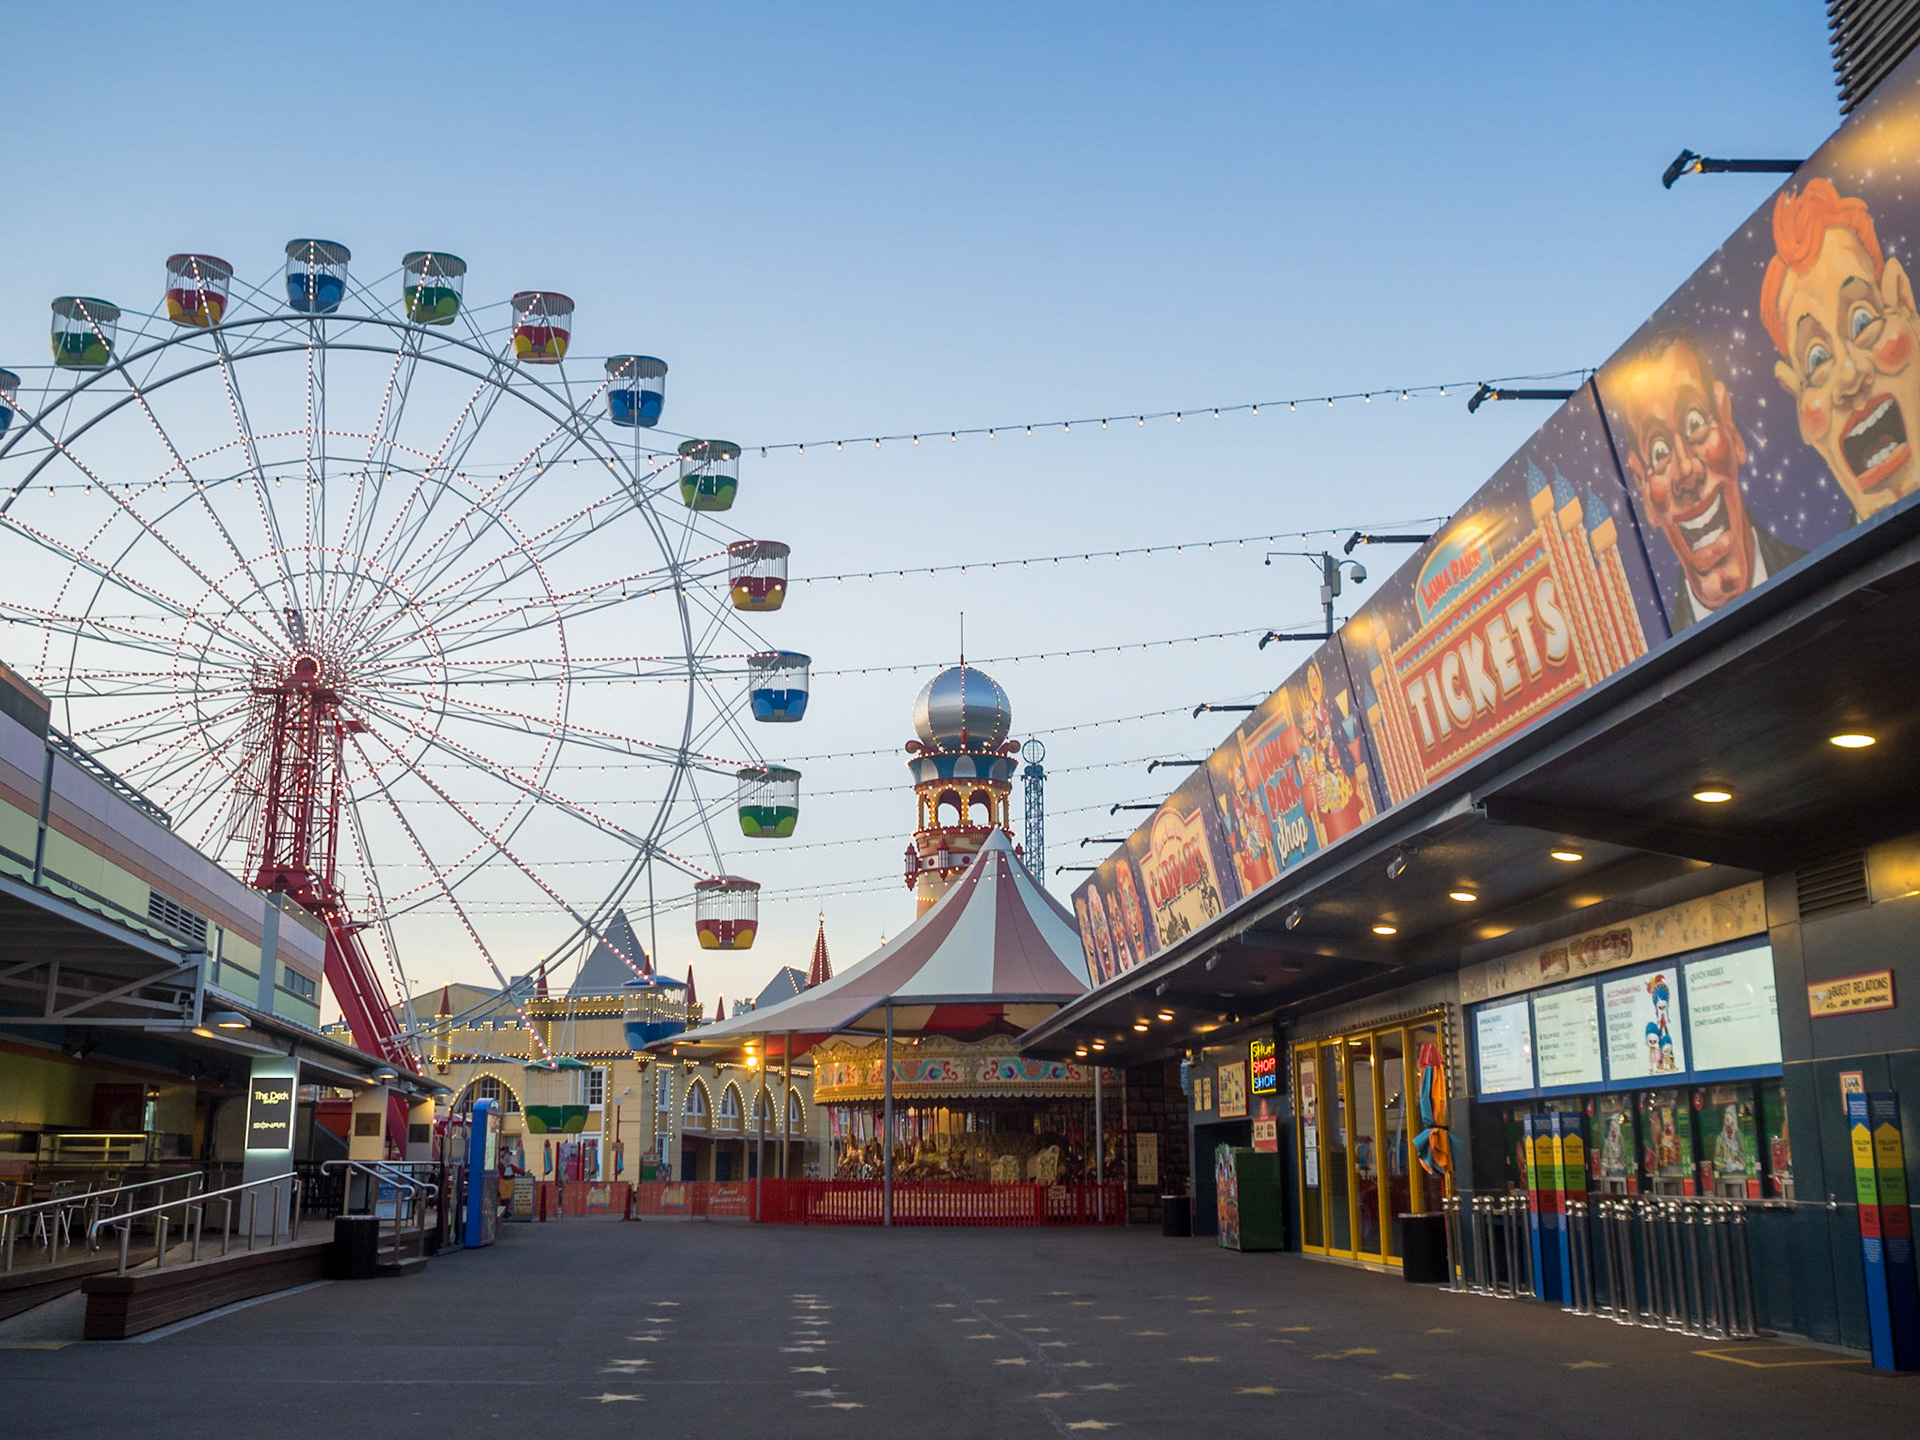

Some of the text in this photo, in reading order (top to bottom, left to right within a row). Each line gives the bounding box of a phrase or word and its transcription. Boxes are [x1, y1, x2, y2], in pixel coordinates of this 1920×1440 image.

[1420, 538, 1482, 614] LUNA PARK
[1406, 577, 1569, 753] TICKETS
[1253, 737, 1291, 787] LUNA
[1265, 767, 1301, 822] PARK
[1277, 814, 1308, 869] Shop
[1149, 833, 1204, 911] CARPARK
[1570, 928, 1633, 969] TICKETS
[1707, 967, 1724, 977] PASSES
[1831, 977, 1888, 997] GUEST RELATIONS
[1253, 1057, 1276, 1073] SHOP
[1254, 1074, 1276, 1089] SHOP
[254, 1091, 289, 1100] The Deck
[253, 1121, 286, 1130] SONAR
